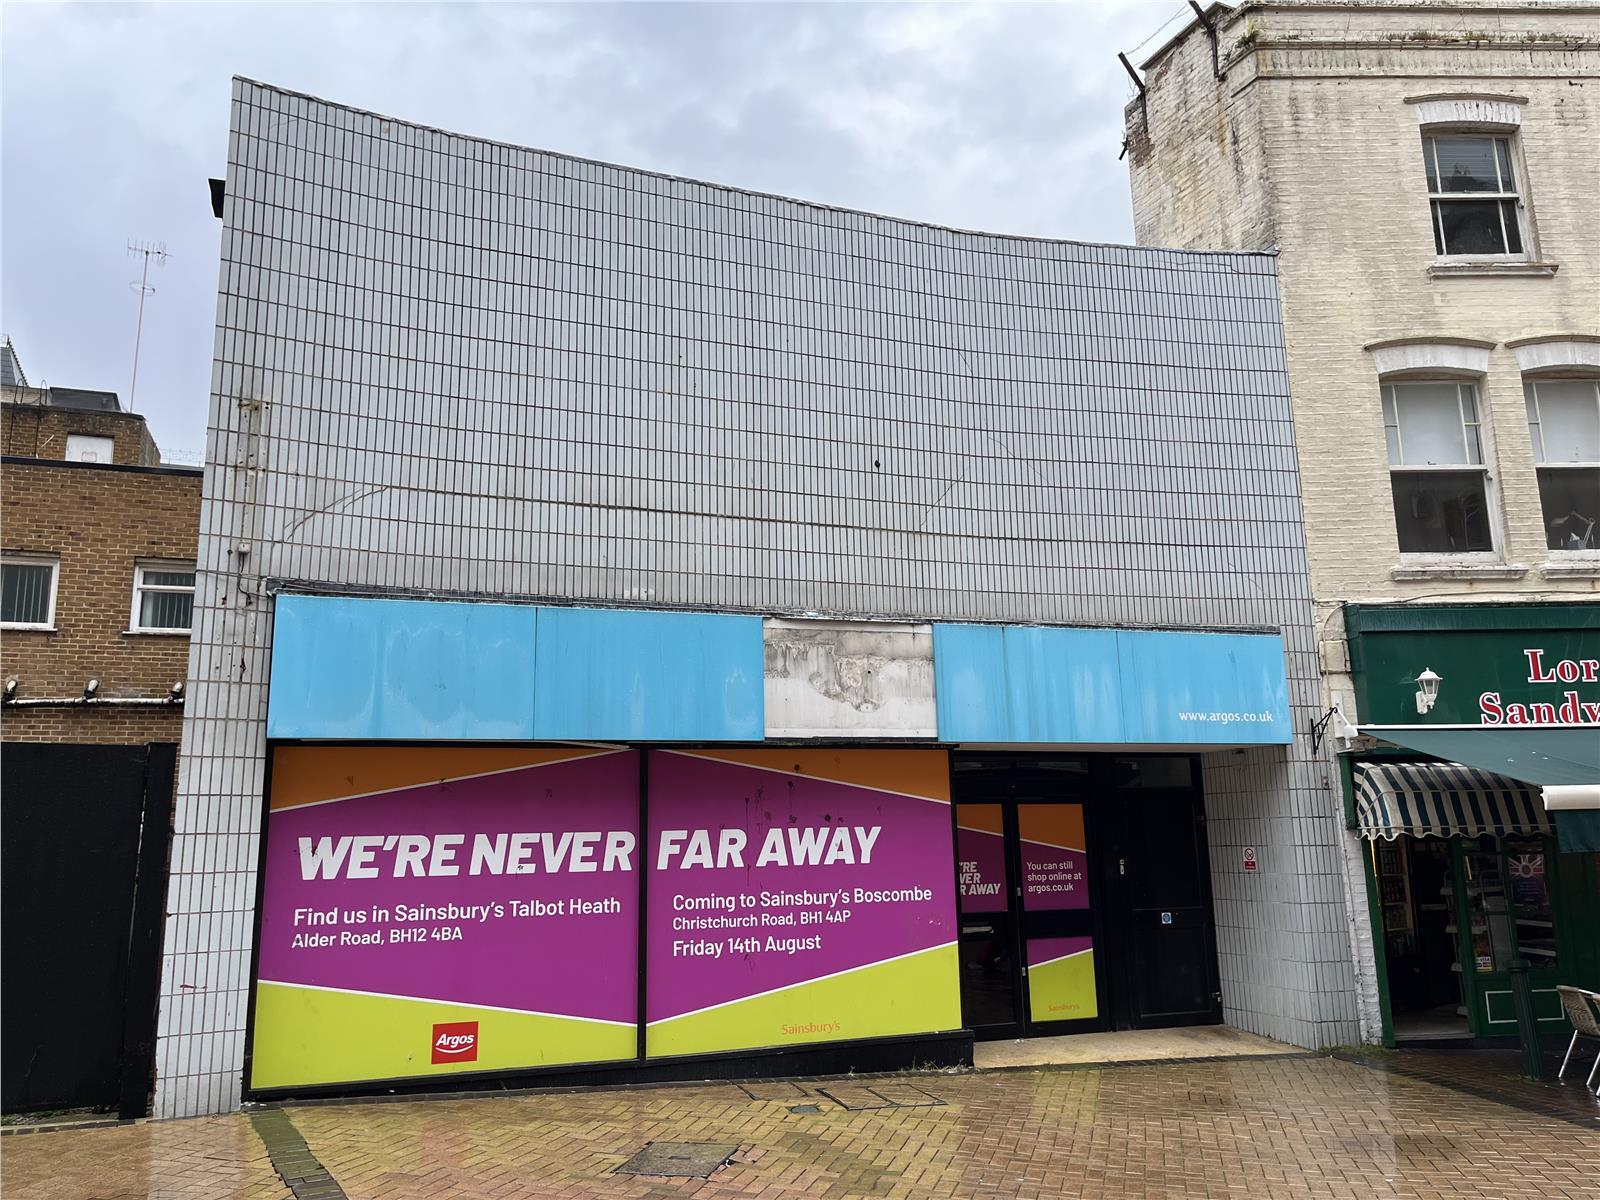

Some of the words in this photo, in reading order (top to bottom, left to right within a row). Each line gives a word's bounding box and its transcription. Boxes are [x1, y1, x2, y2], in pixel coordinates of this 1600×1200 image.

[1524, 649, 1599, 683] Lor
[1179, 711, 1273, 725] www.argos.co.uk
[298, 835, 464, 880] WE'RE
[469, 831, 636, 875] NEVER
[656, 828, 747, 870] FAR
[756, 826, 882, 867] AWAY
[1027, 862, 1041, 870] You
[1059, 861, 1073, 869] still
[1027, 873, 1047, 883] shop
[1048, 872, 1072, 881] online
[1074, 872, 1082, 880] at
[969, 883, 1001, 895] AWAY
[1028, 882, 1074, 894] argos.co.uk
[673, 893, 735, 912] Coming
[739, 893, 756, 908] to
[760, 888, 850, 907] Sainsbury's
[854, 885, 932, 904] Boscombe
[294, 907, 338, 926] Find
[343, 910, 367, 924] us
[372, 905, 389, 923] in
[395, 902, 504, 922] Sainsbury's
[509, 900, 564, 917] Talbot
[569, 897, 621, 915] Heath
[673, 914, 758, 930] Christchurch
[762, 912, 797, 926] Road,
[800, 910, 823, 925] BH1
[826, 909, 851, 923] 4AP
[292, 933, 336, 948] Alder
[340, 930, 384, 946] Road,
[390, 928, 427, 943] BH12
[431, 926, 463, 941] 4BA
[673, 939, 723, 958] Friday
[727, 937, 761, 954] 14th
[765, 934, 821, 954] August
[782, 1021, 841, 1035] Sainsbury's
[436, 1033, 474, 1048] Argos
